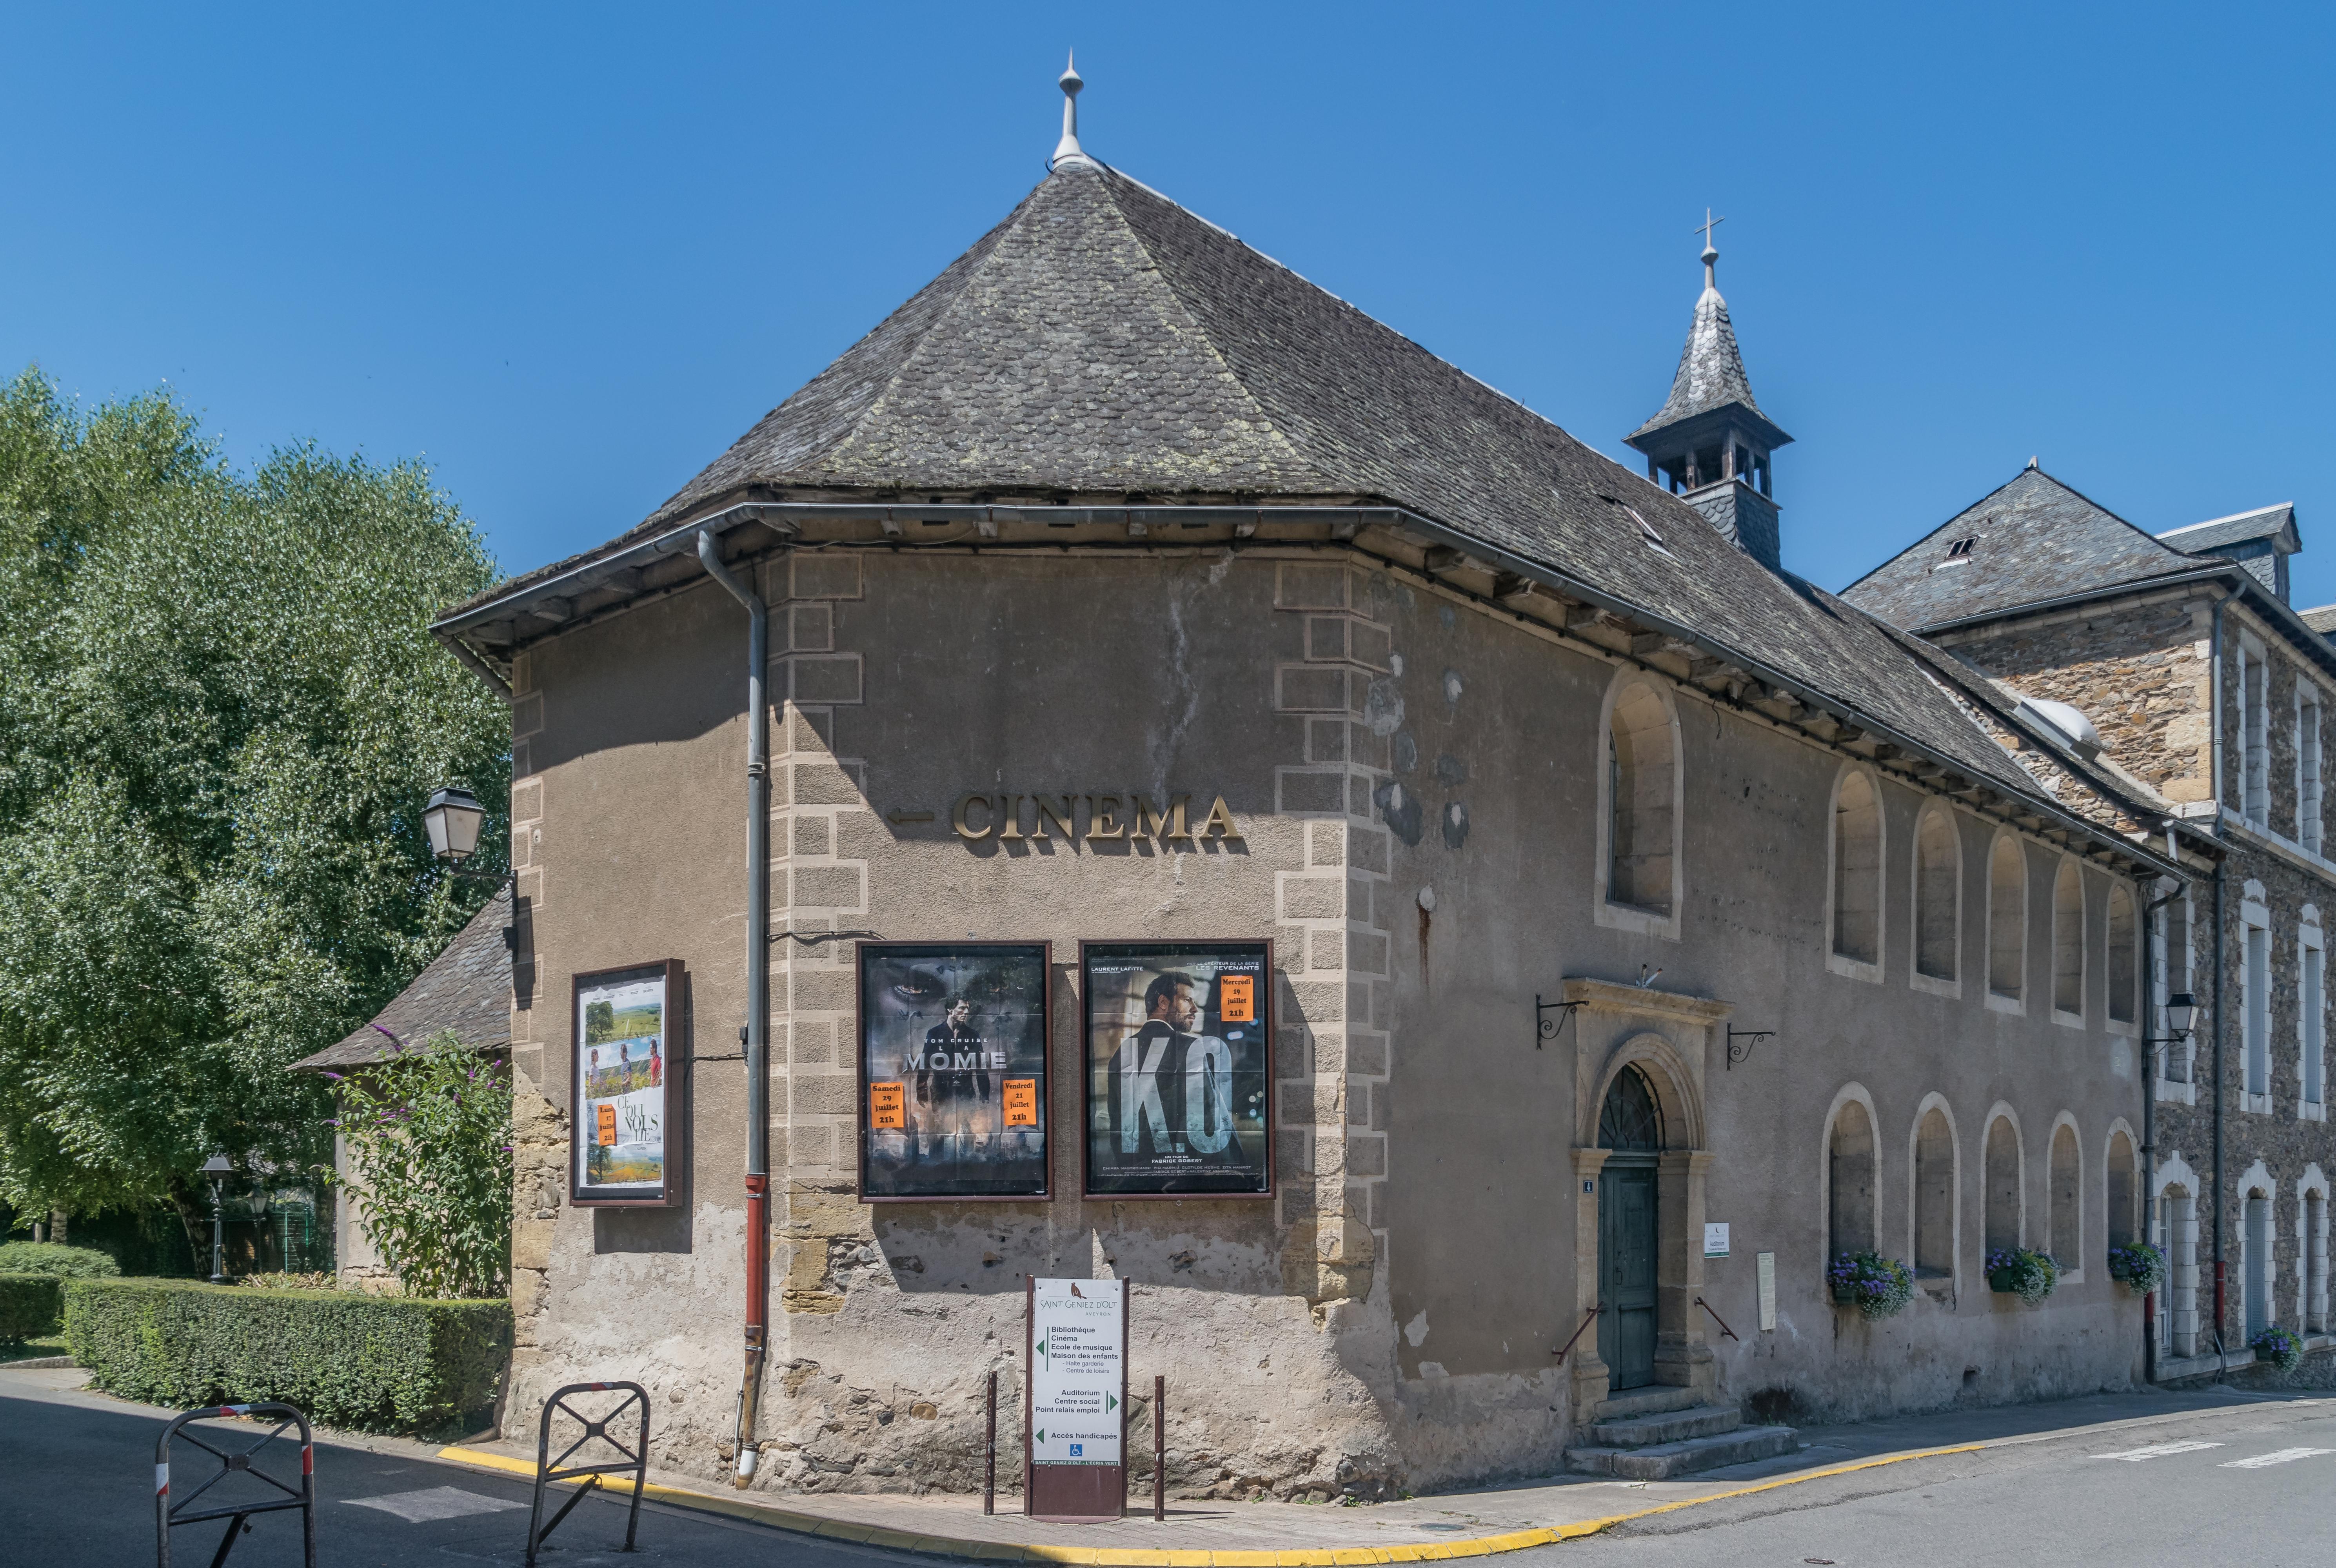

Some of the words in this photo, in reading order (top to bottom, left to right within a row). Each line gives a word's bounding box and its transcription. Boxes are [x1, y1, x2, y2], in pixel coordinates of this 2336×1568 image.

[952, 793, 1242, 840] CINEMA
[902, 1052, 1007, 1073] MOMIE
[1587, 1182, 1591, 1191] 4
[1040, 1299, 1063, 1310] SAINT
[1065, 1300, 1094, 1308] GENIEZ
